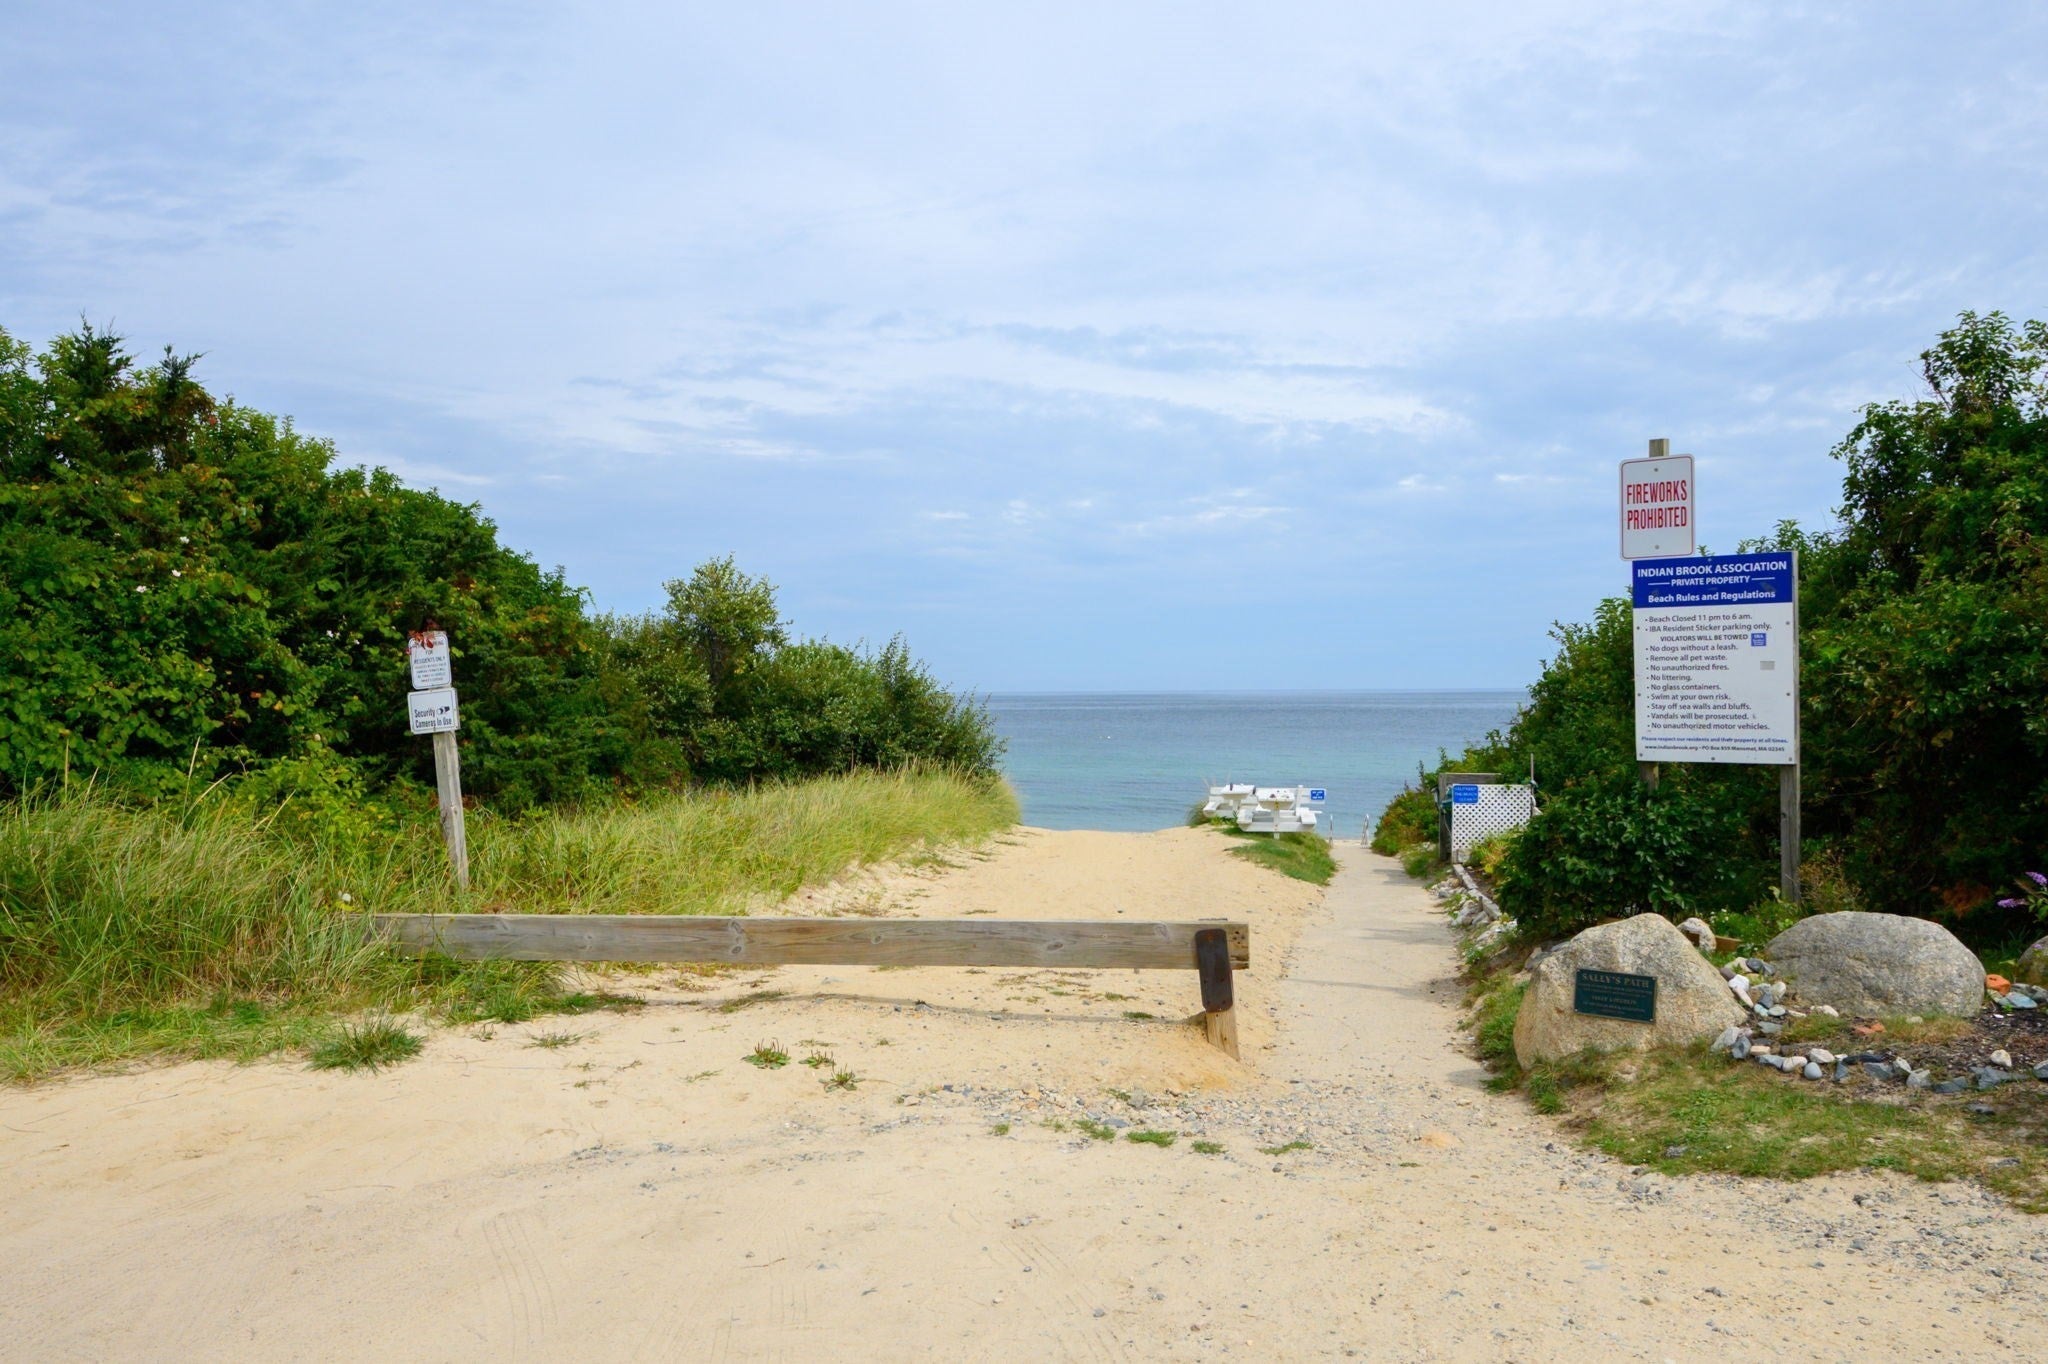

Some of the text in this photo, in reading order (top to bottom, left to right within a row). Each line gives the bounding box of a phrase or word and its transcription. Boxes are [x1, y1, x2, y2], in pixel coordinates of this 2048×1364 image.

[1627, 480, 1687, 504] FIREWORKS
[1627, 506, 1687, 530] PROHIBITED
[1638, 561, 1787, 577] INDIAN BROOK ASSOCIATION
[1671, 576, 1750, 586] PRIVATE PROPERTY
[1649, 590, 1775, 603] Beach Rules and Regulations
[1723, 624, 1751, 632] parking
[1754, 623, 1771, 631] only.
[1662, 645, 1678, 653] dogs
[1662, 674, 1692, 682] littering.
[1663, 684, 1679, 692] glass
[414, 708, 435, 718] Security
[1706, 713, 1749, 721] prosecuted.
[415, 720, 436, 728] Cameras
[1582, 973, 1649, 988] SALLY'S PATH
